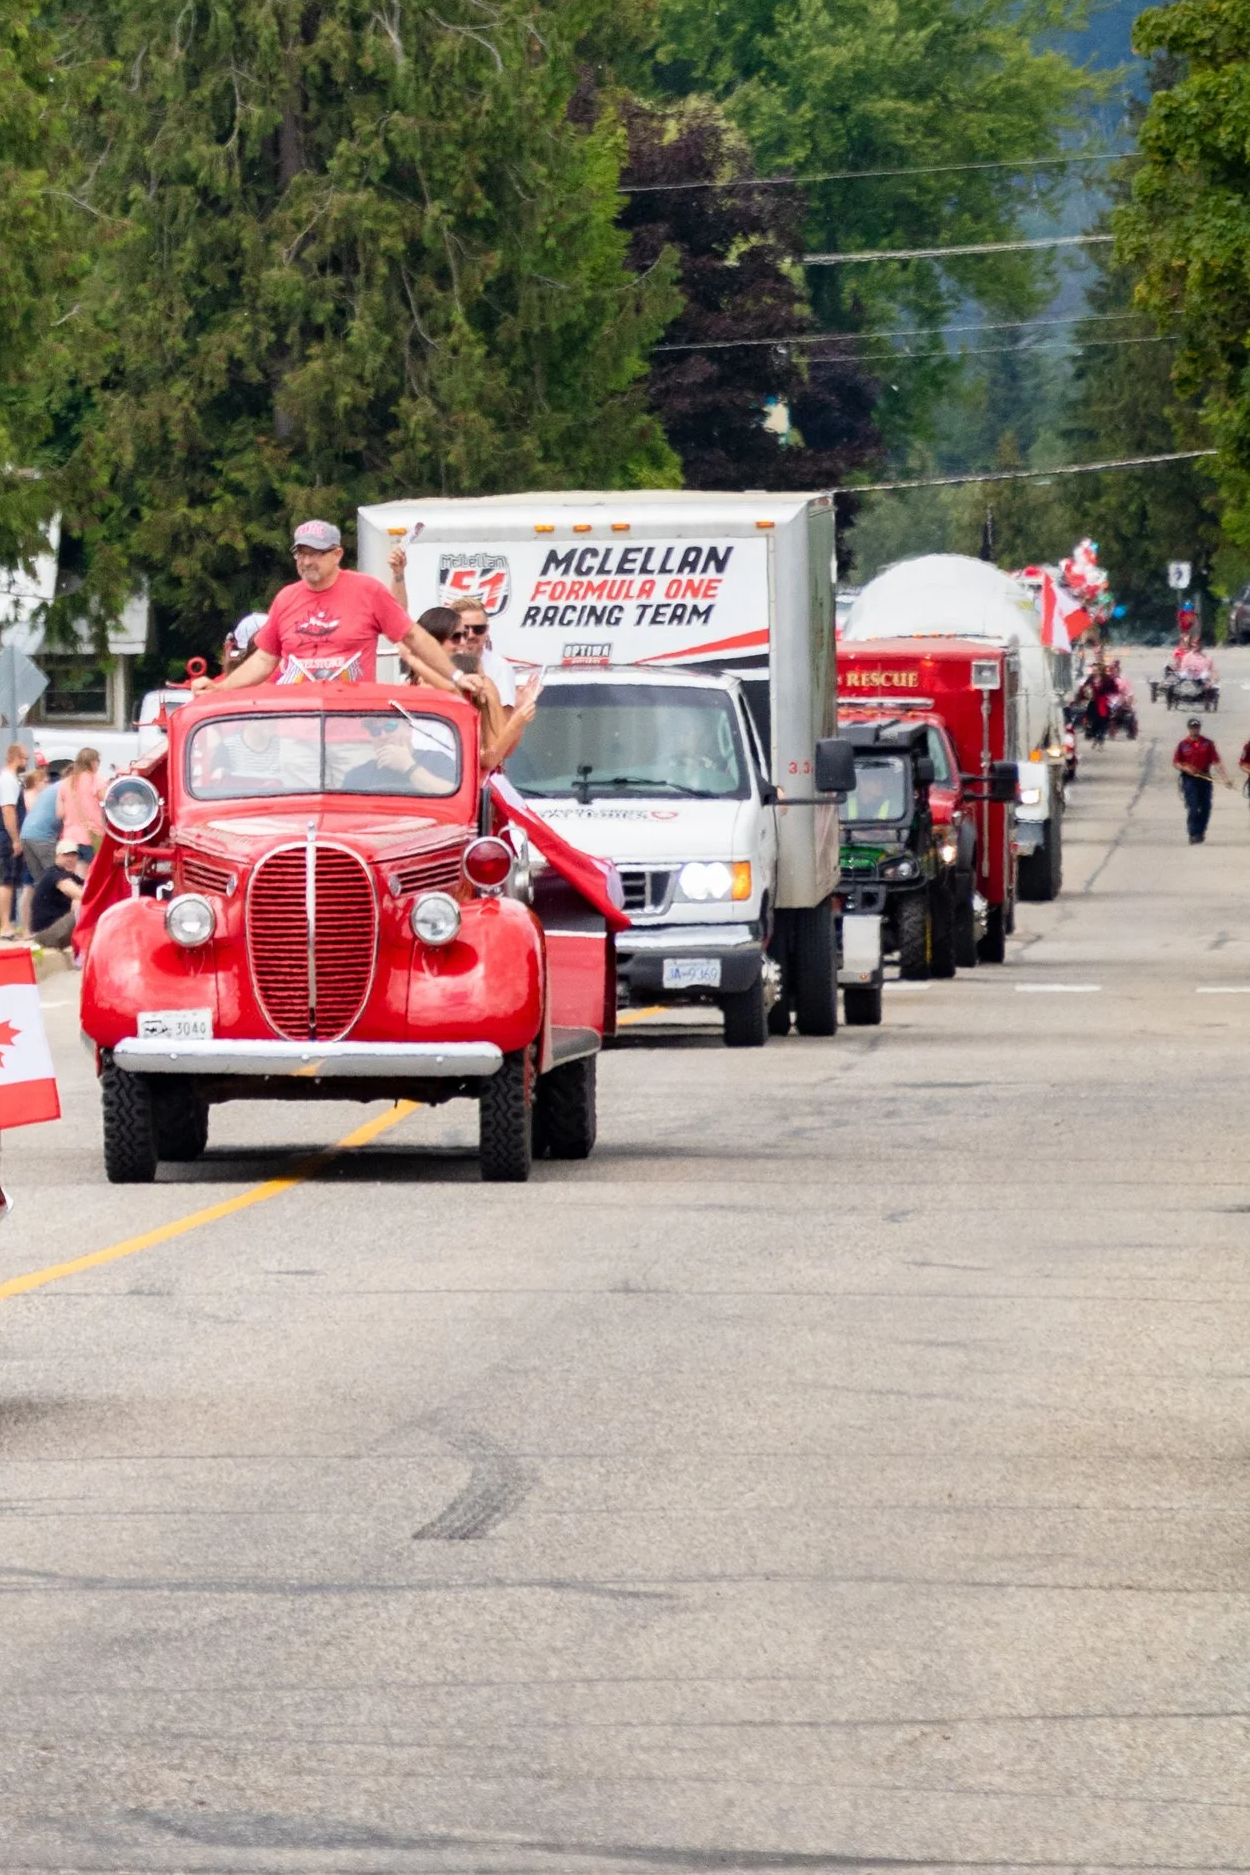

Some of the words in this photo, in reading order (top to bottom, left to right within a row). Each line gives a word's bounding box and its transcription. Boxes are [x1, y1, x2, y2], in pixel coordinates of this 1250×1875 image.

[540, 546, 734, 576] MCLELLAN
[531, 578, 656, 602] FORMULA
[664, 578, 722, 600] ONE
[520, 604, 624, 627] RACING
[635, 603, 716, 626] TEAM
[846, 671, 918, 687] RESCUE
